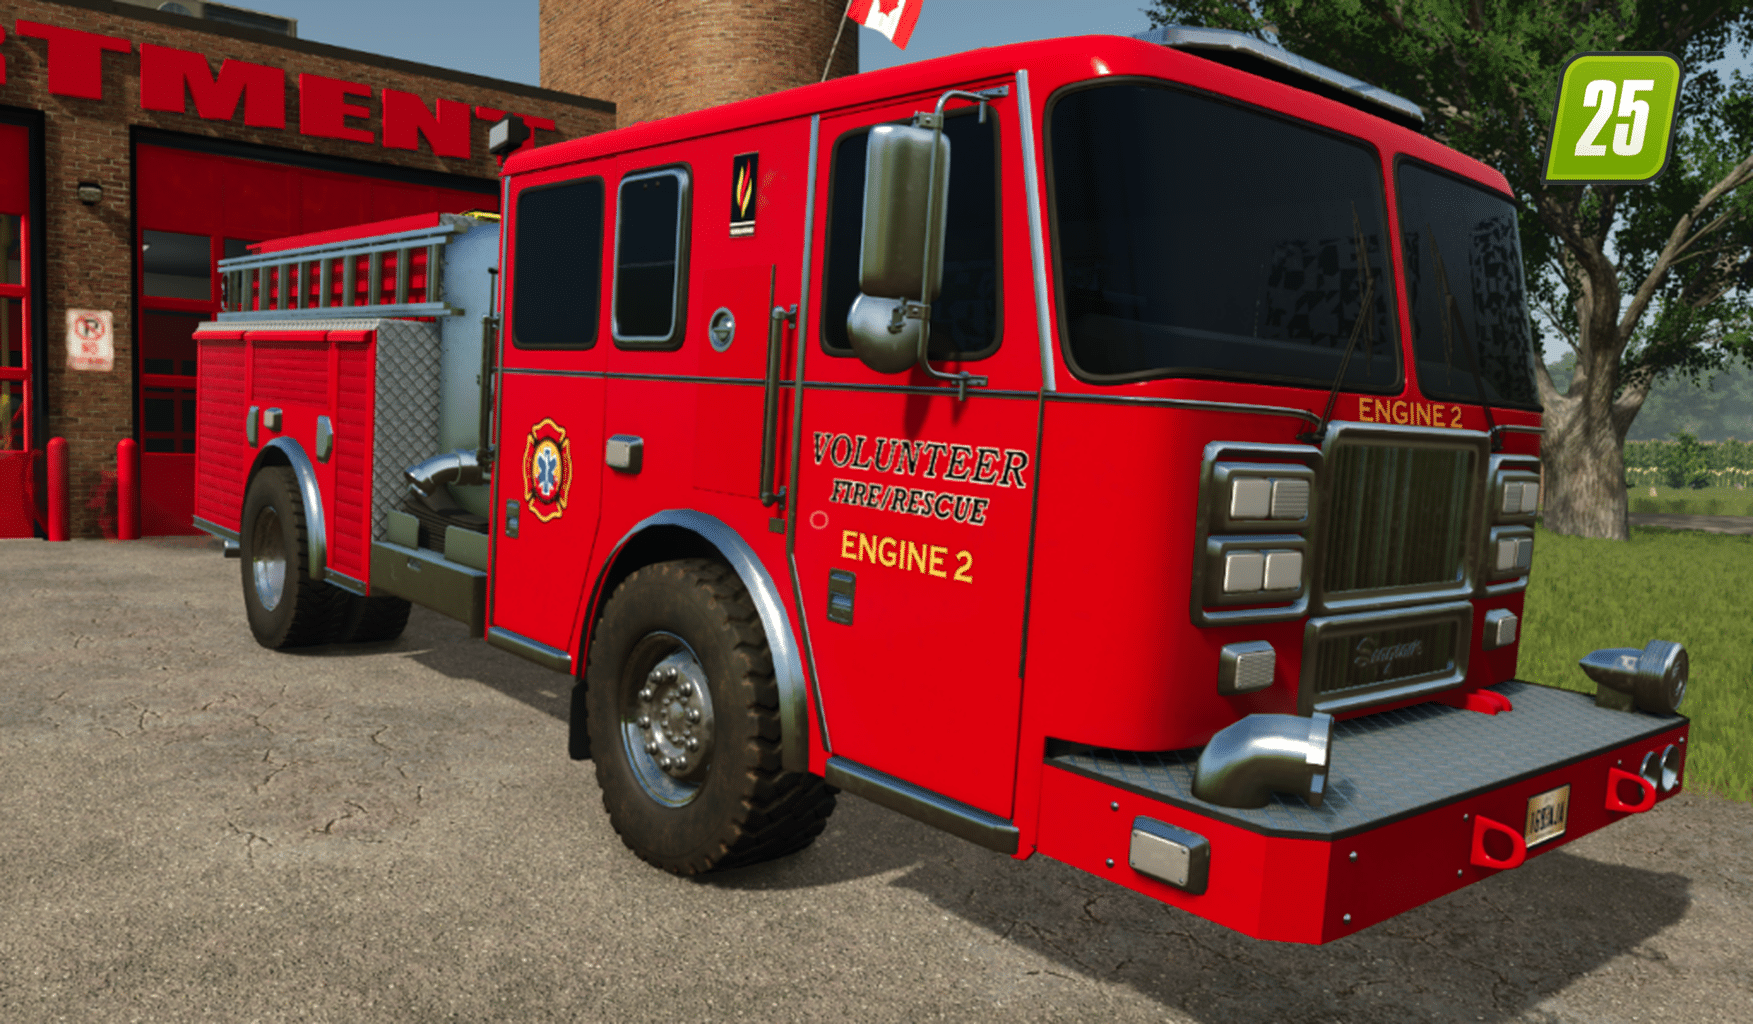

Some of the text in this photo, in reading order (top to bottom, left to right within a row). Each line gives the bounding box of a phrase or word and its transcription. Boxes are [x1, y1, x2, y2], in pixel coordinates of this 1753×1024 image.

[1359, 397, 1463, 429] ENGINE 2
[813, 432, 1029, 489] VOLUNTEER
[829, 478, 990, 526] FIRE/RESCUE
[840, 529, 974, 584] ENGINE 2
